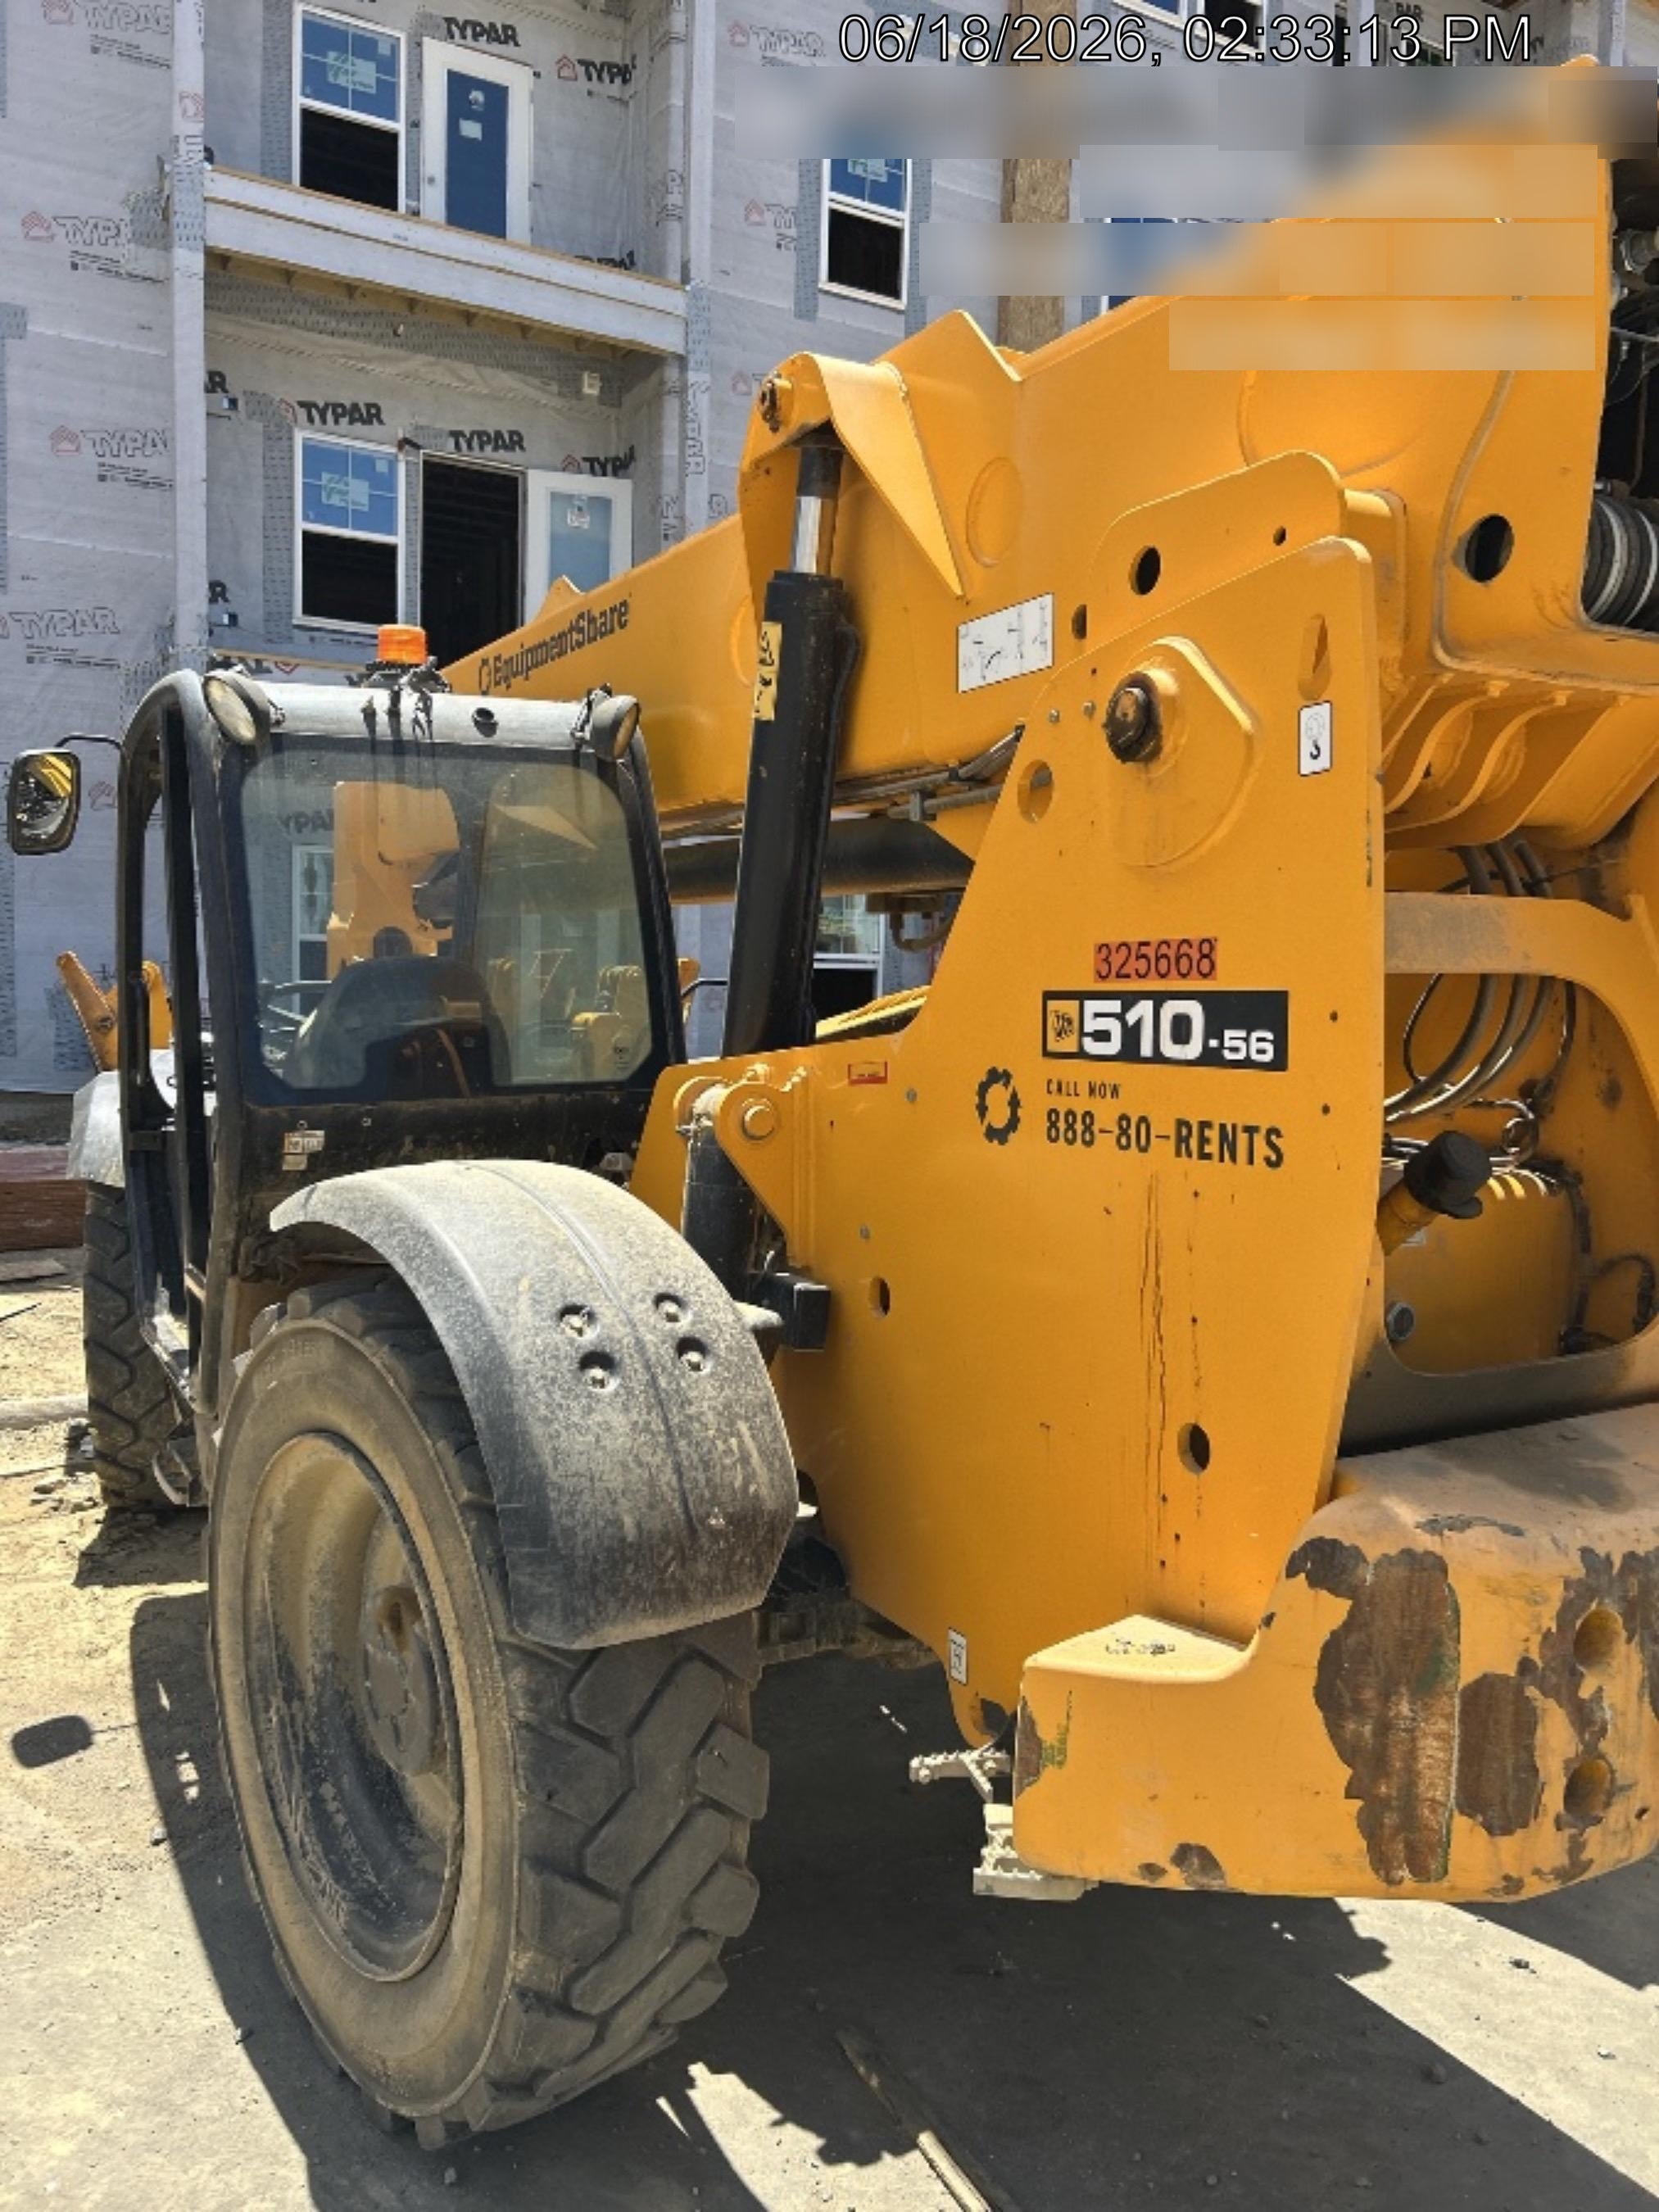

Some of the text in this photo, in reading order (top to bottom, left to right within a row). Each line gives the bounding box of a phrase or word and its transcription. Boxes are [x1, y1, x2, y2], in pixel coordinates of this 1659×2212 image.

[442, 16, 520, 47] TYPAR
[297, 400, 386, 425] TYPAR
[448, 429, 526, 451] TYPAR
[8, 605, 120, 639] TYPAR
[493, 599, 628, 691] EquipmentShare
[1096, 938, 1214, 979] 325668
[1046, 1078, 1121, 1099] CALL NOW
[1046, 1108, 1284, 1169] 888-80-RENTS
